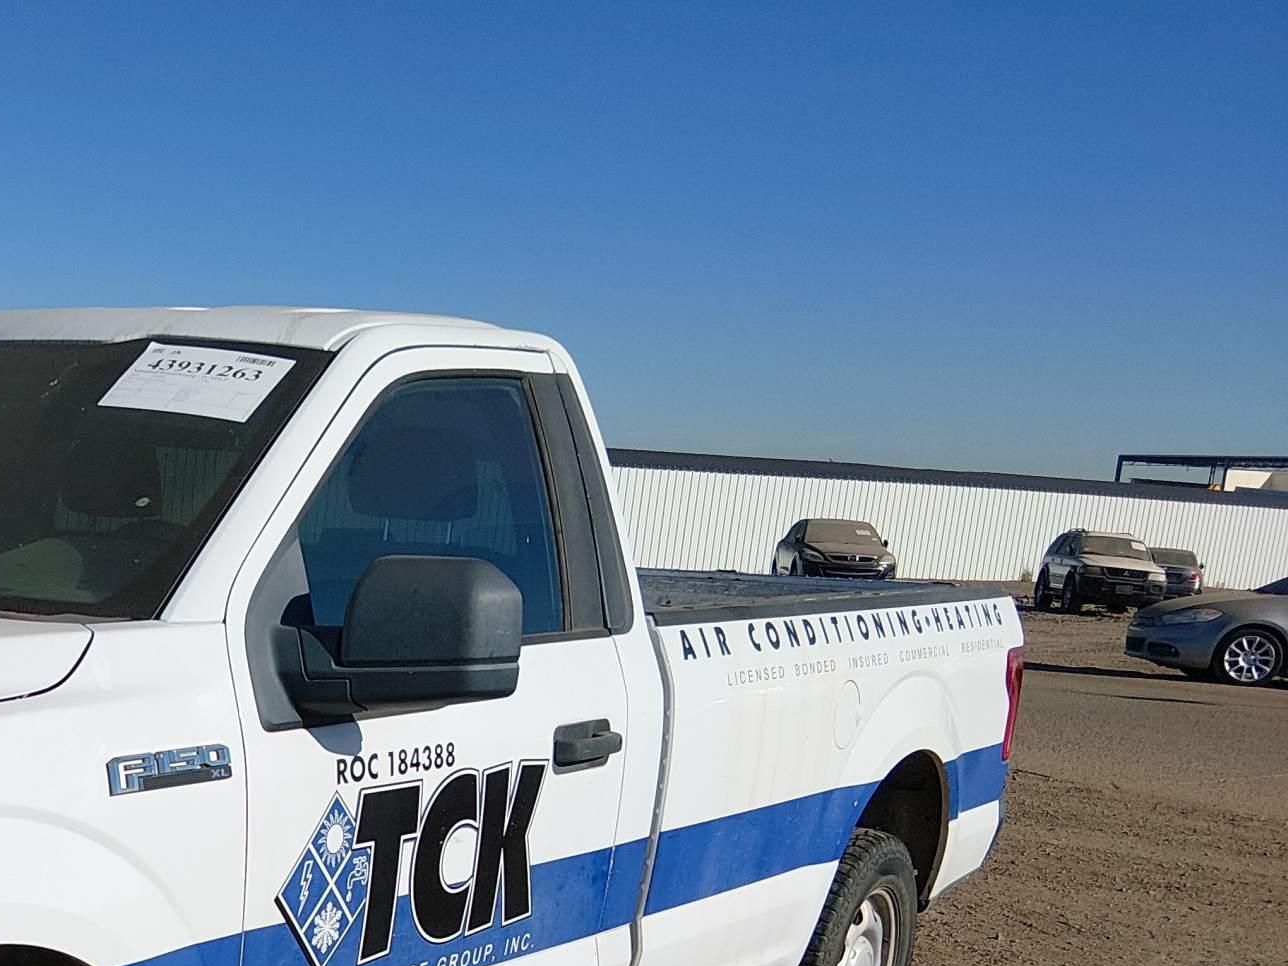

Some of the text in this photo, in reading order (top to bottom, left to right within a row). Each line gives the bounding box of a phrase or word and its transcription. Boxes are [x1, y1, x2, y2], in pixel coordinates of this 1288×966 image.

[146, 358, 264, 383] 43931263
[679, 626, 732, 661] AIR
[727, 638, 1004, 687] LICENSED BONDED INSURED COMMERCIAL RESIDENTIAL
[210, 767, 230, 779] XL
[336, 742, 455, 785] ROC 184388
[352, 759, 549, 966] TCK
[503, 933, 535, 957] INC.
